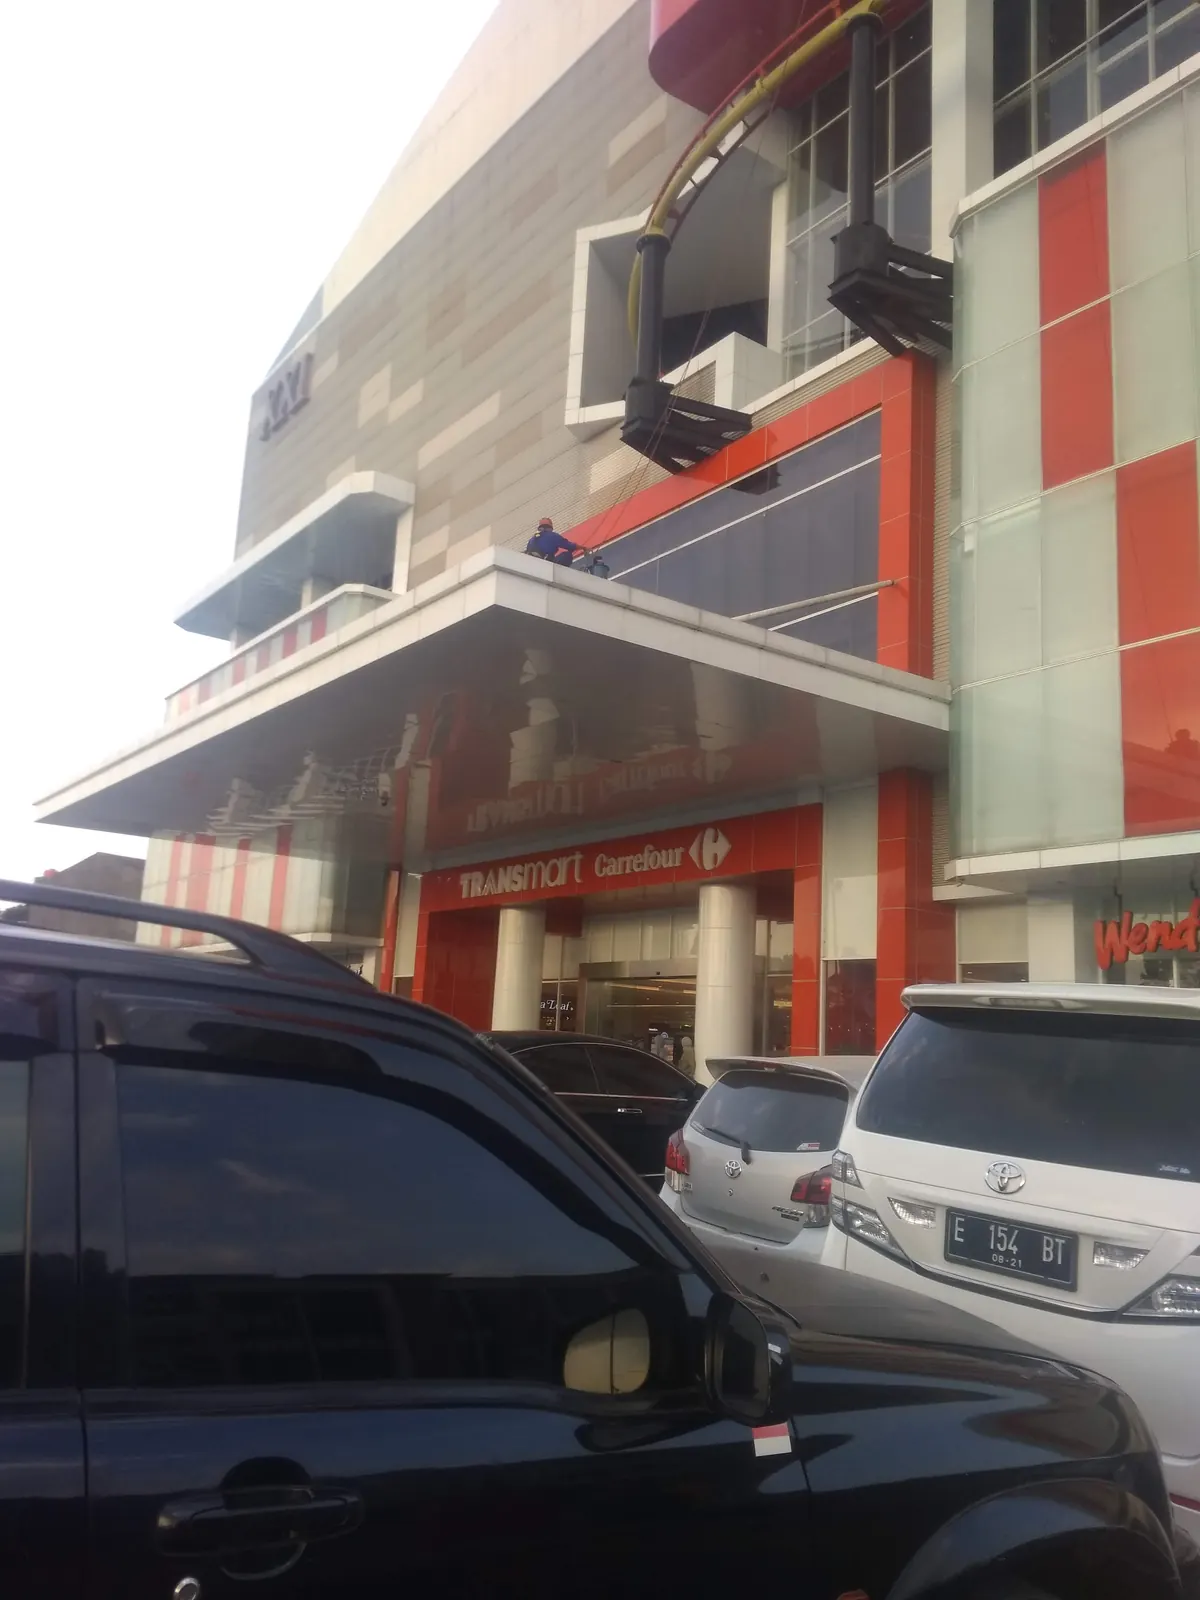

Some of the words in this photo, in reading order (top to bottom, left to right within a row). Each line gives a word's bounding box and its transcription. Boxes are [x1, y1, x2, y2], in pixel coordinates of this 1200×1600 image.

[594, 843, 685, 877] Carrefour
[953, 1216, 965, 1242] E
[988, 1224, 1019, 1254] 154
[1042, 1235, 1066, 1265] BT
